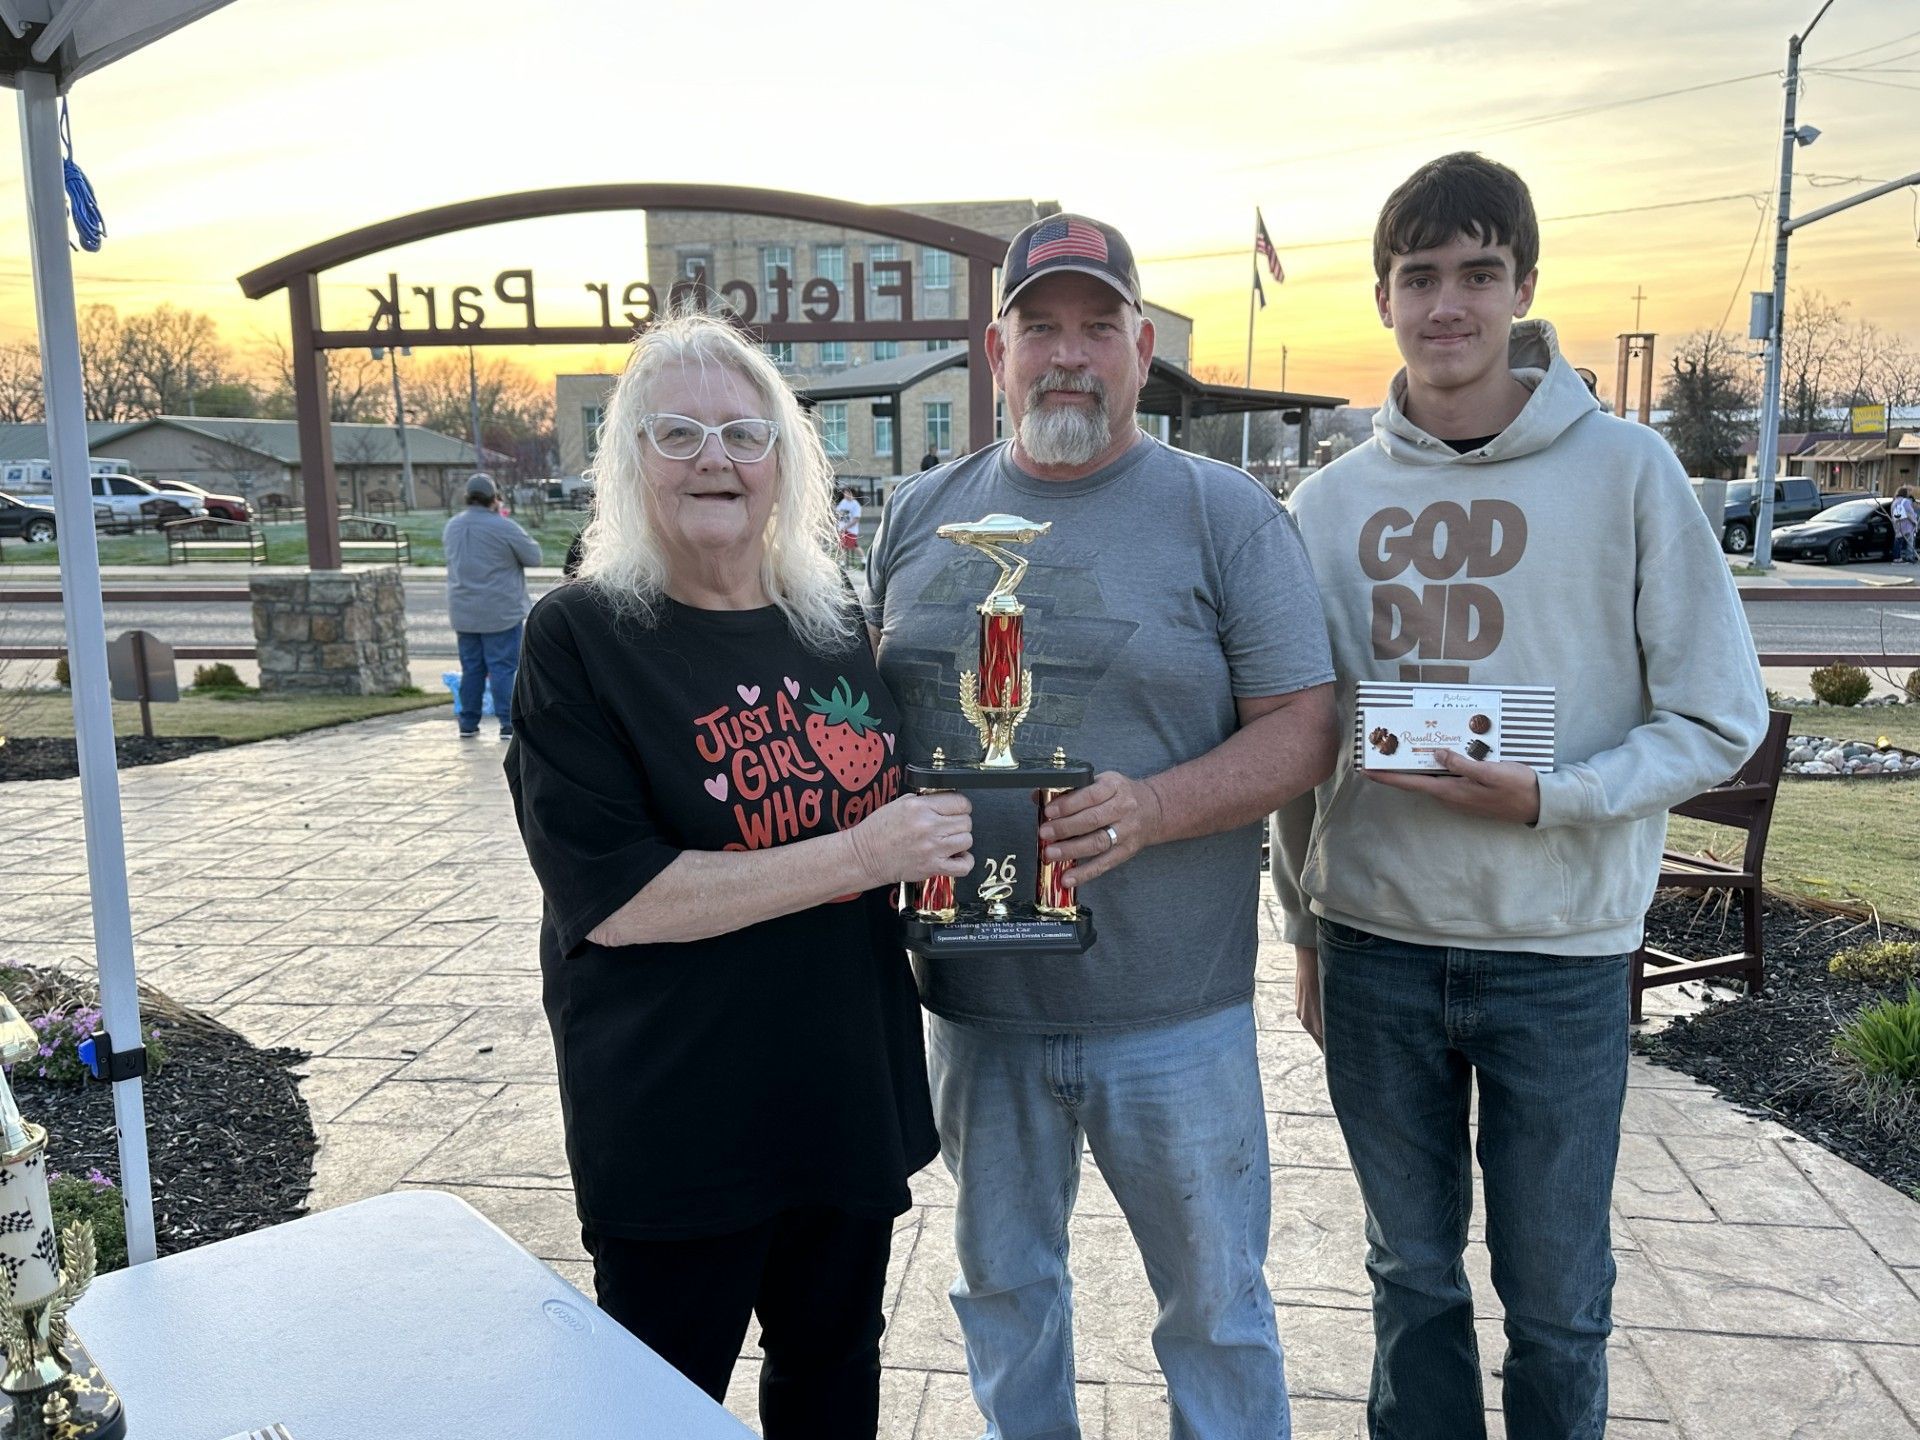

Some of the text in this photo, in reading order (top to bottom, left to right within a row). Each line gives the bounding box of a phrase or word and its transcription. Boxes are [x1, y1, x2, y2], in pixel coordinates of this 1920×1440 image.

[1358, 499, 1528, 581] GOD
[1372, 583, 1504, 660] DID
[694, 690, 801, 763] JUST A
[1400, 731, 1462, 745] Russell Stover
[731, 736, 824, 801] GIRL
[734, 785, 823, 850] WHO
[983, 854, 1017, 887] 26
